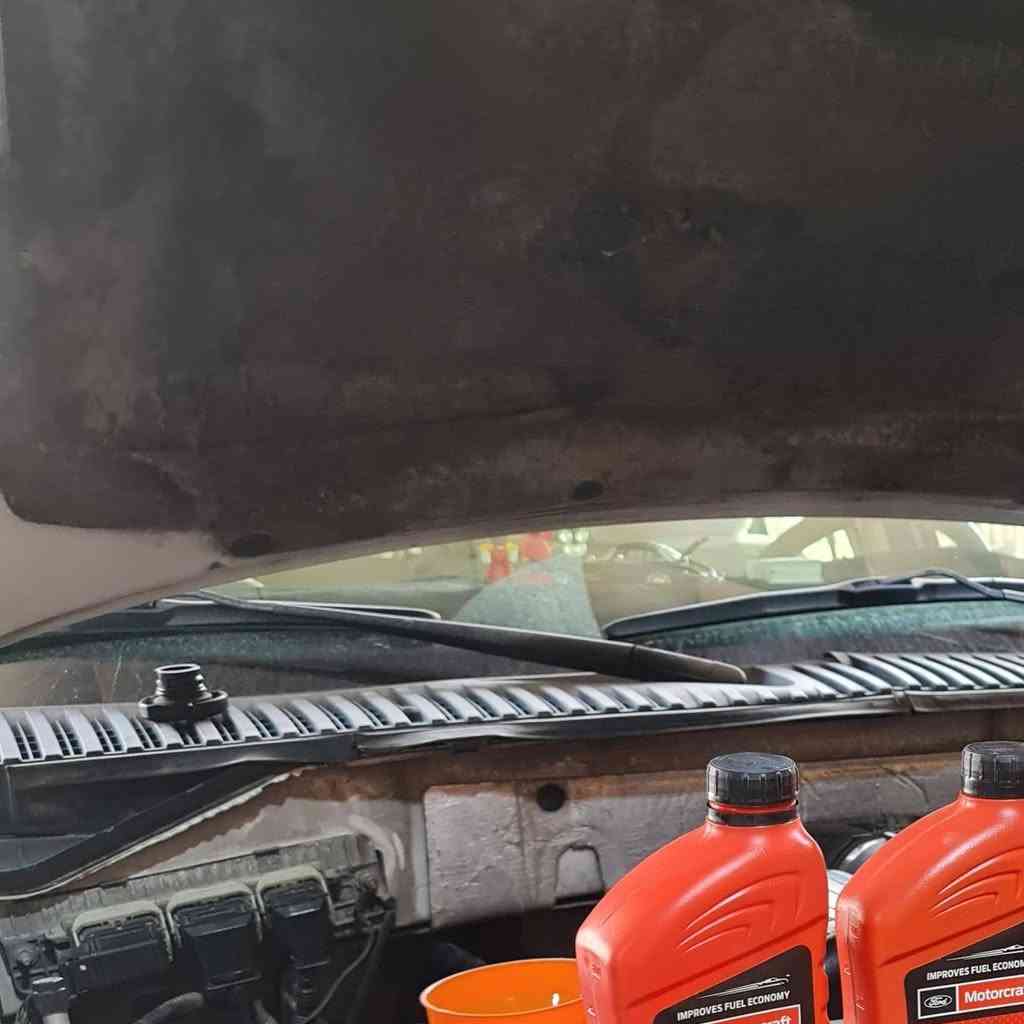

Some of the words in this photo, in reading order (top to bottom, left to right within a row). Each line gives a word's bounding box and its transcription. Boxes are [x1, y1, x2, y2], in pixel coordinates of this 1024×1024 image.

[926, 967, 970, 981] IMPROVES
[970, 963, 992, 975] FUEL
[677, 1003, 724, 1021] IMPROVES
[724, 999, 746, 1012] FUEL
[747, 990, 791, 1007] ECONOMY
[928, 995, 949, 1008] Ford
